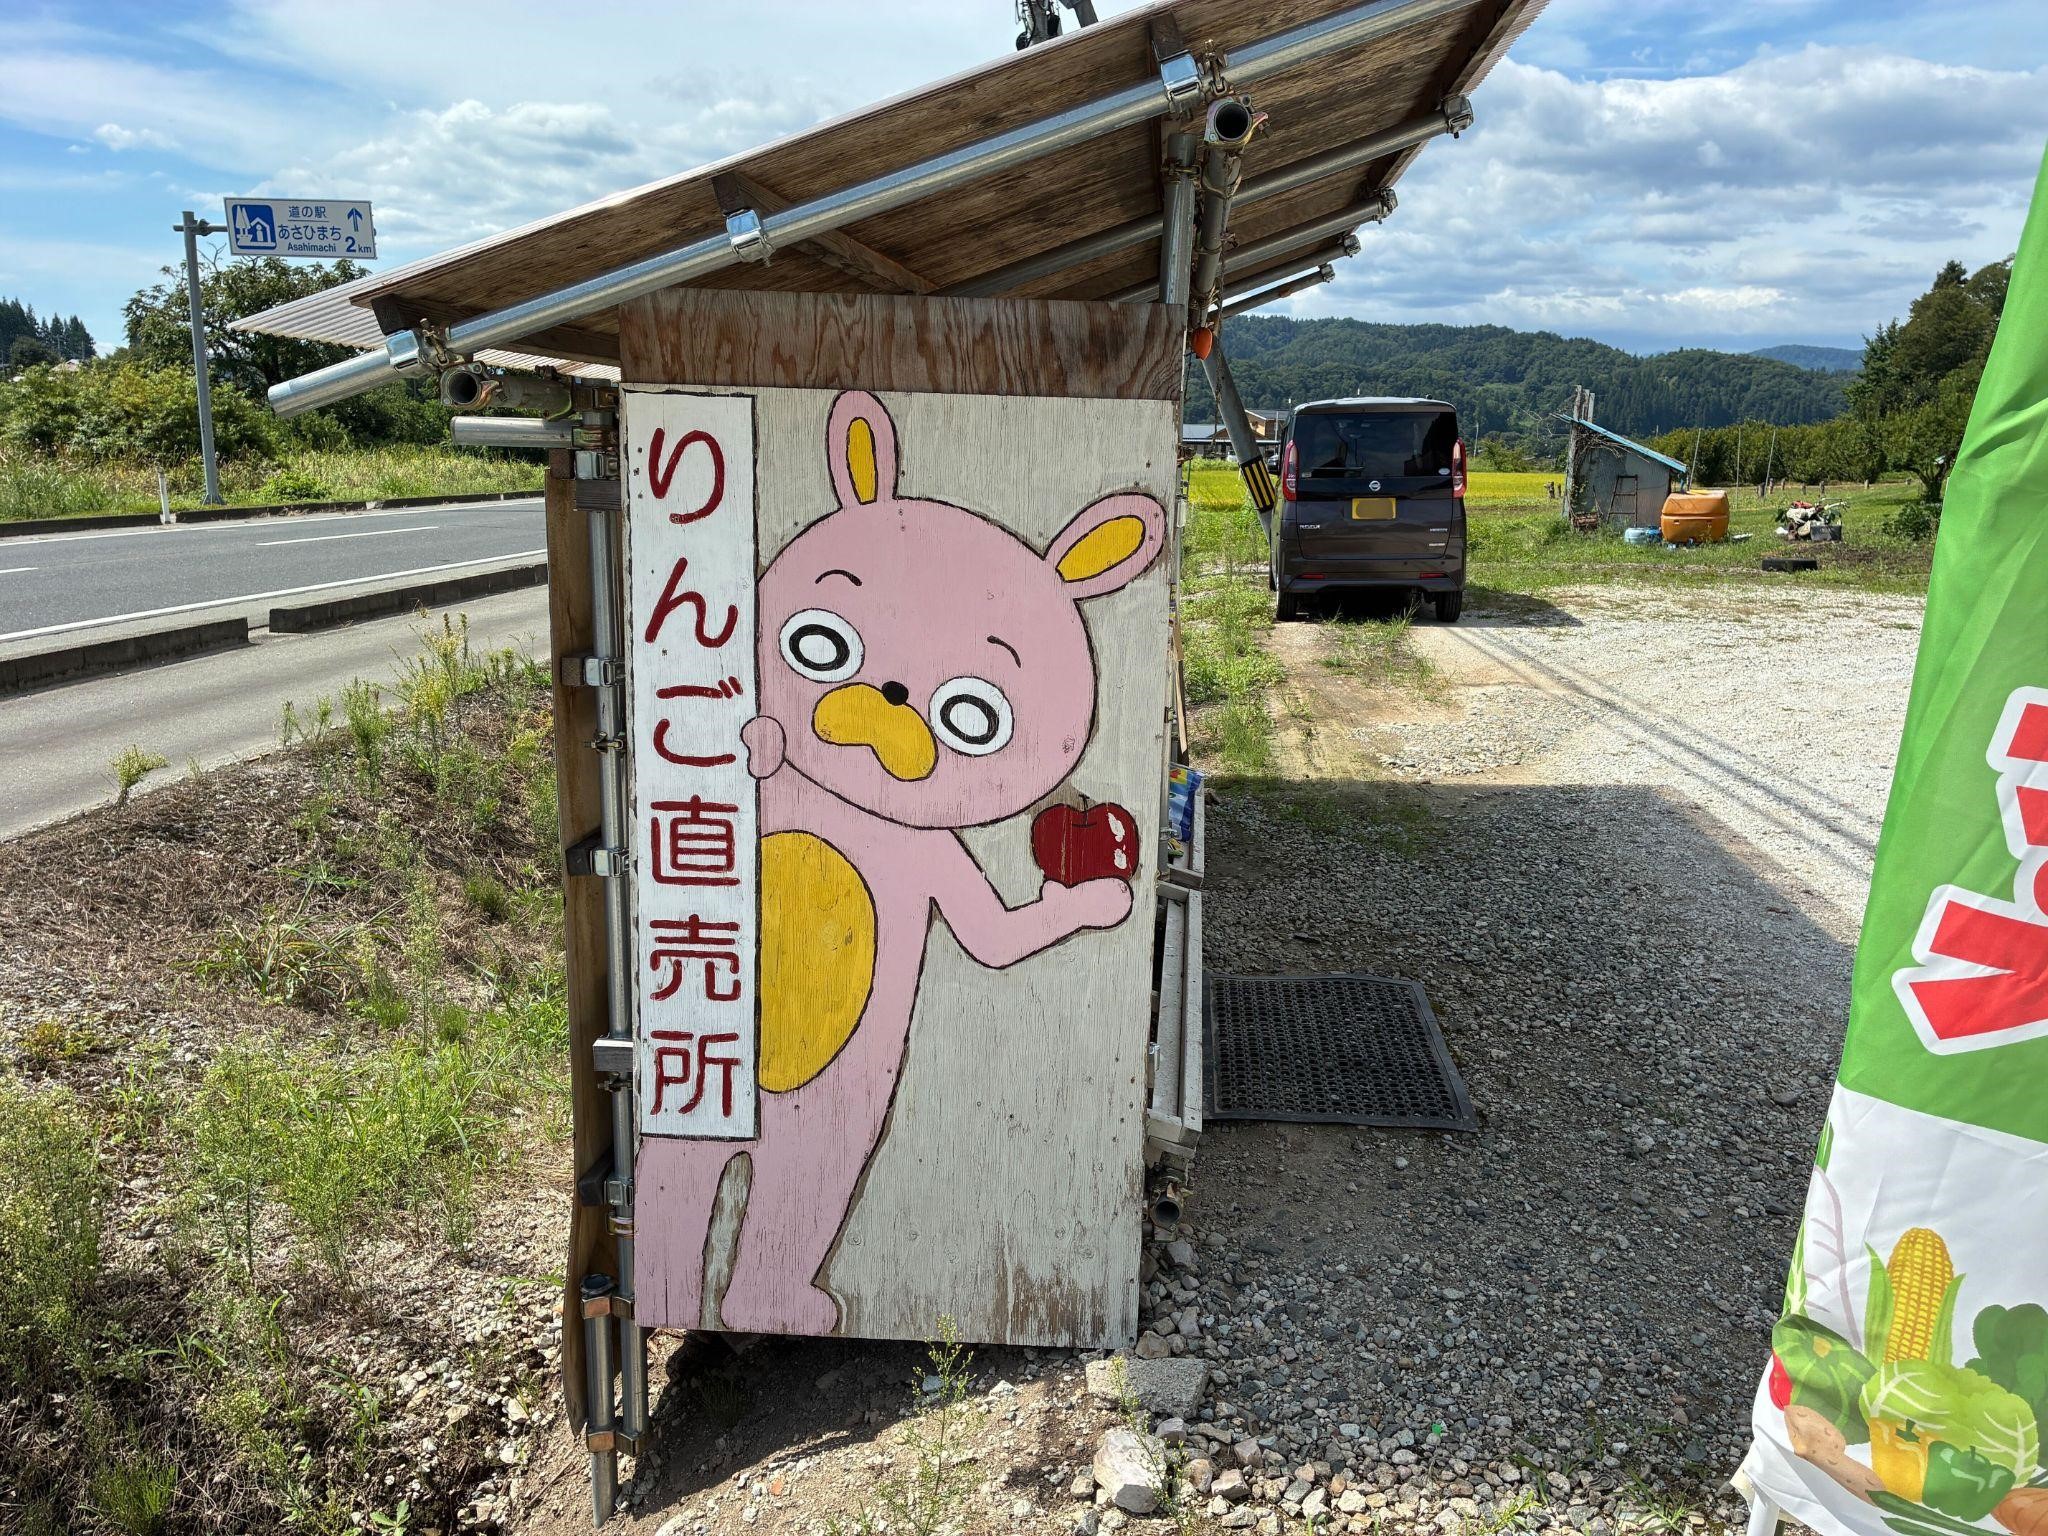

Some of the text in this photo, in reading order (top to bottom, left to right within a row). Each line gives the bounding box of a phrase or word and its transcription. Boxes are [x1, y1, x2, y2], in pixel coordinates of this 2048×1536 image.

[288, 205, 327, 219] 道の駅
[277, 224, 342, 241] あさひまち
[287, 242, 337, 253] Asahimachi
[645, 427, 743, 1117] りんご直売所
